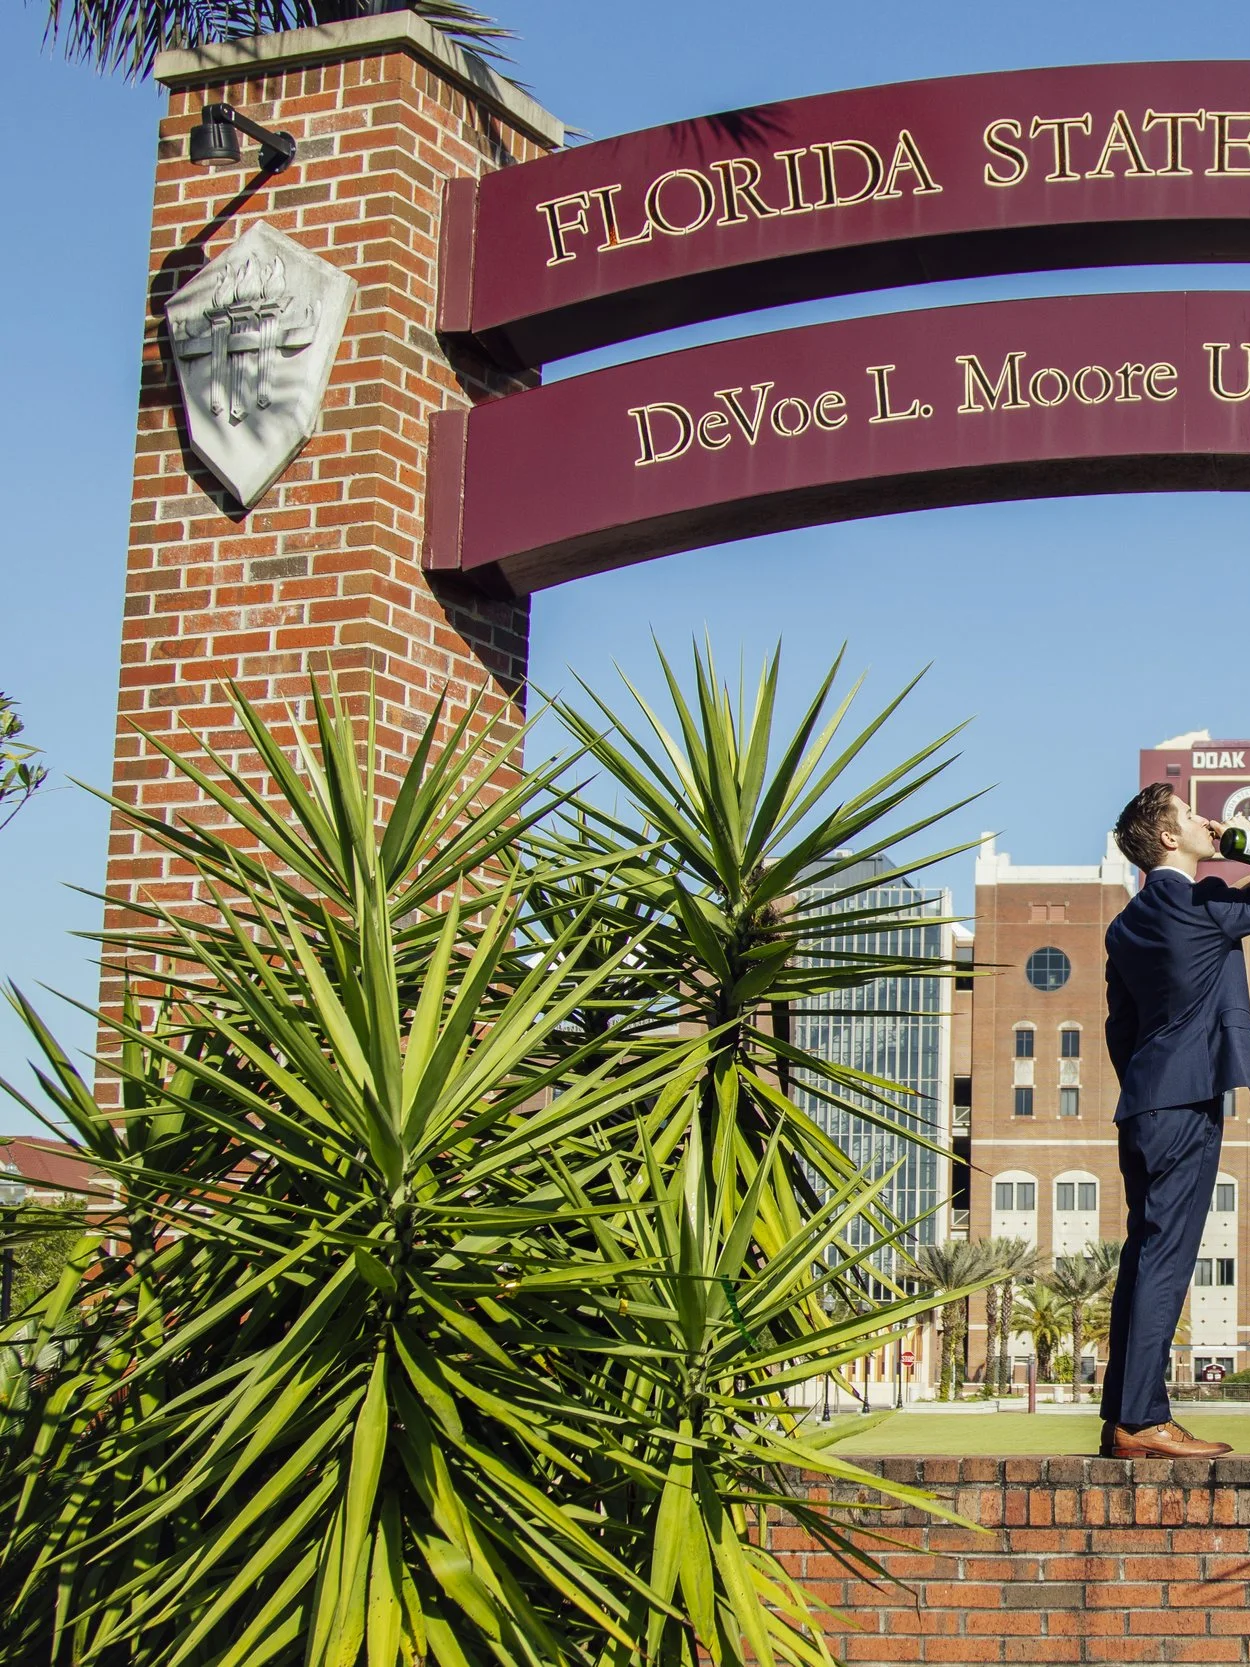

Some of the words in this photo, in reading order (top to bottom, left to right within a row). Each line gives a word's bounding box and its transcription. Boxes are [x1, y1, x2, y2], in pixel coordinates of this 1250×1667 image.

[536, 129, 943, 266] FLORIDA
[628, 381, 848, 467] DeVoe
[867, 364, 933, 424] L.
[956, 351, 1178, 413] Moore
[1192, 751, 1246, 768] DOAK
